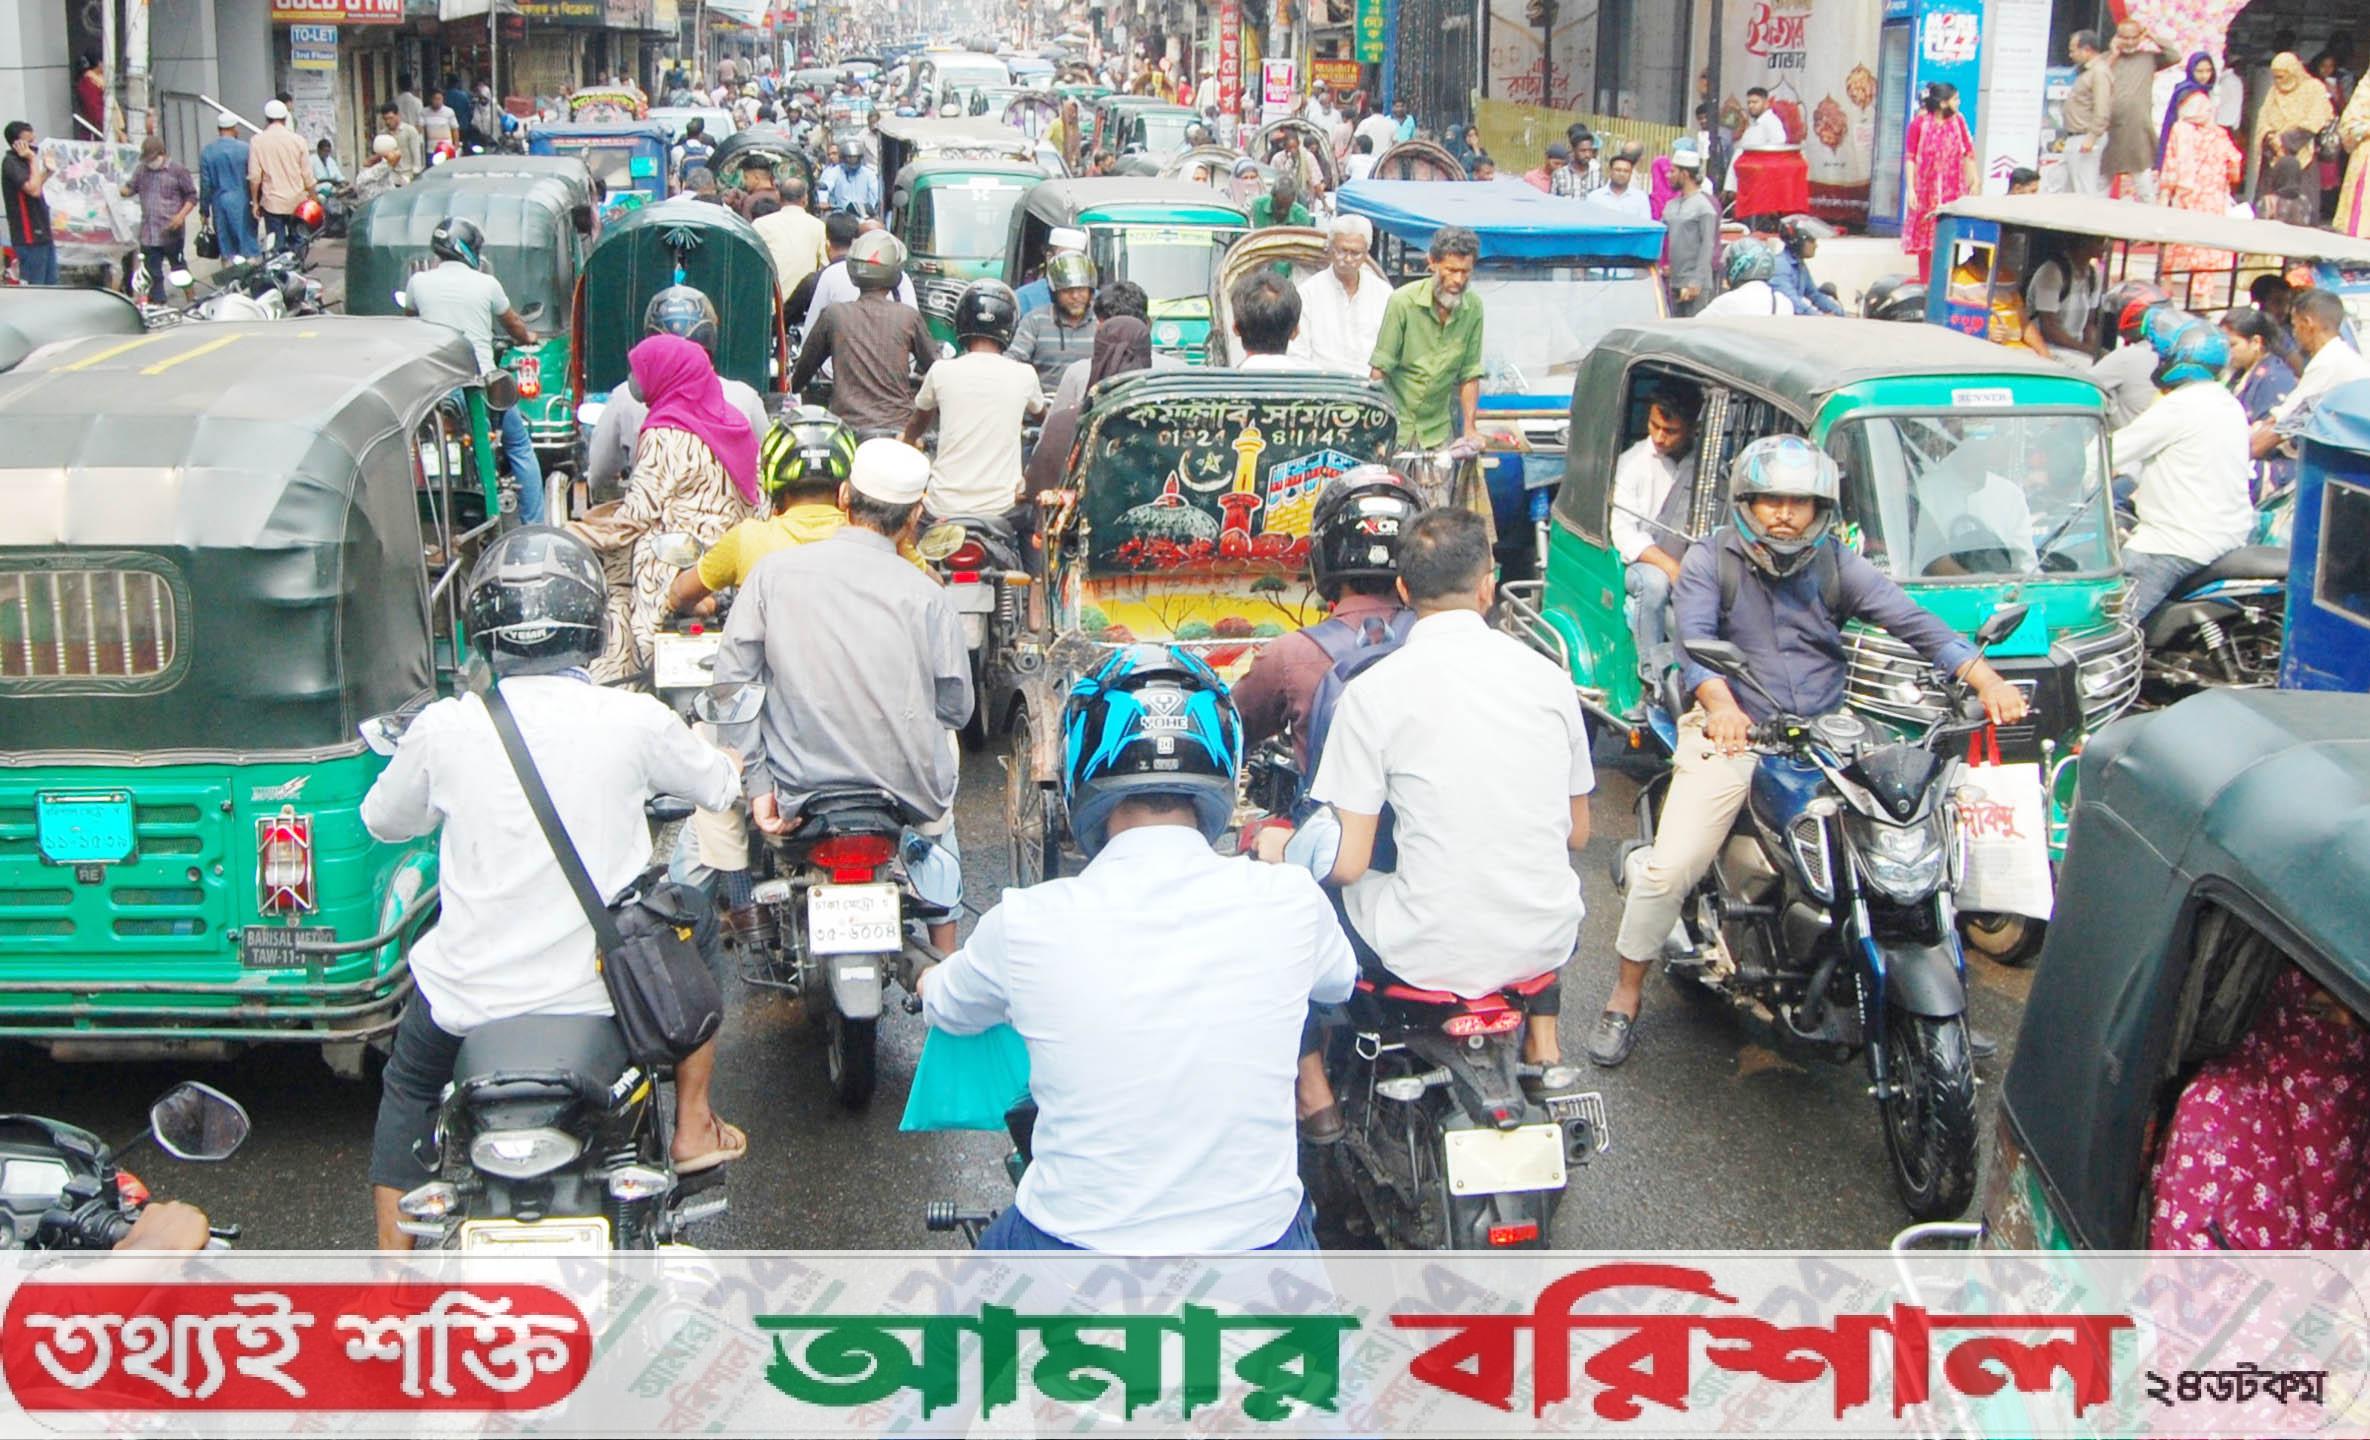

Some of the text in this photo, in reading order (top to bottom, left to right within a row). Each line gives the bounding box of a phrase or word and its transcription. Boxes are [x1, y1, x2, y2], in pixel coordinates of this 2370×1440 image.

[293, 27, 334, 42] TO-LET
[1355, 518, 1399, 535] AXOR
[1140, 716, 1188, 729] YOHE
[80, 868, 100, 881] RE
[247, 931, 334, 946] BARISAL METRO
